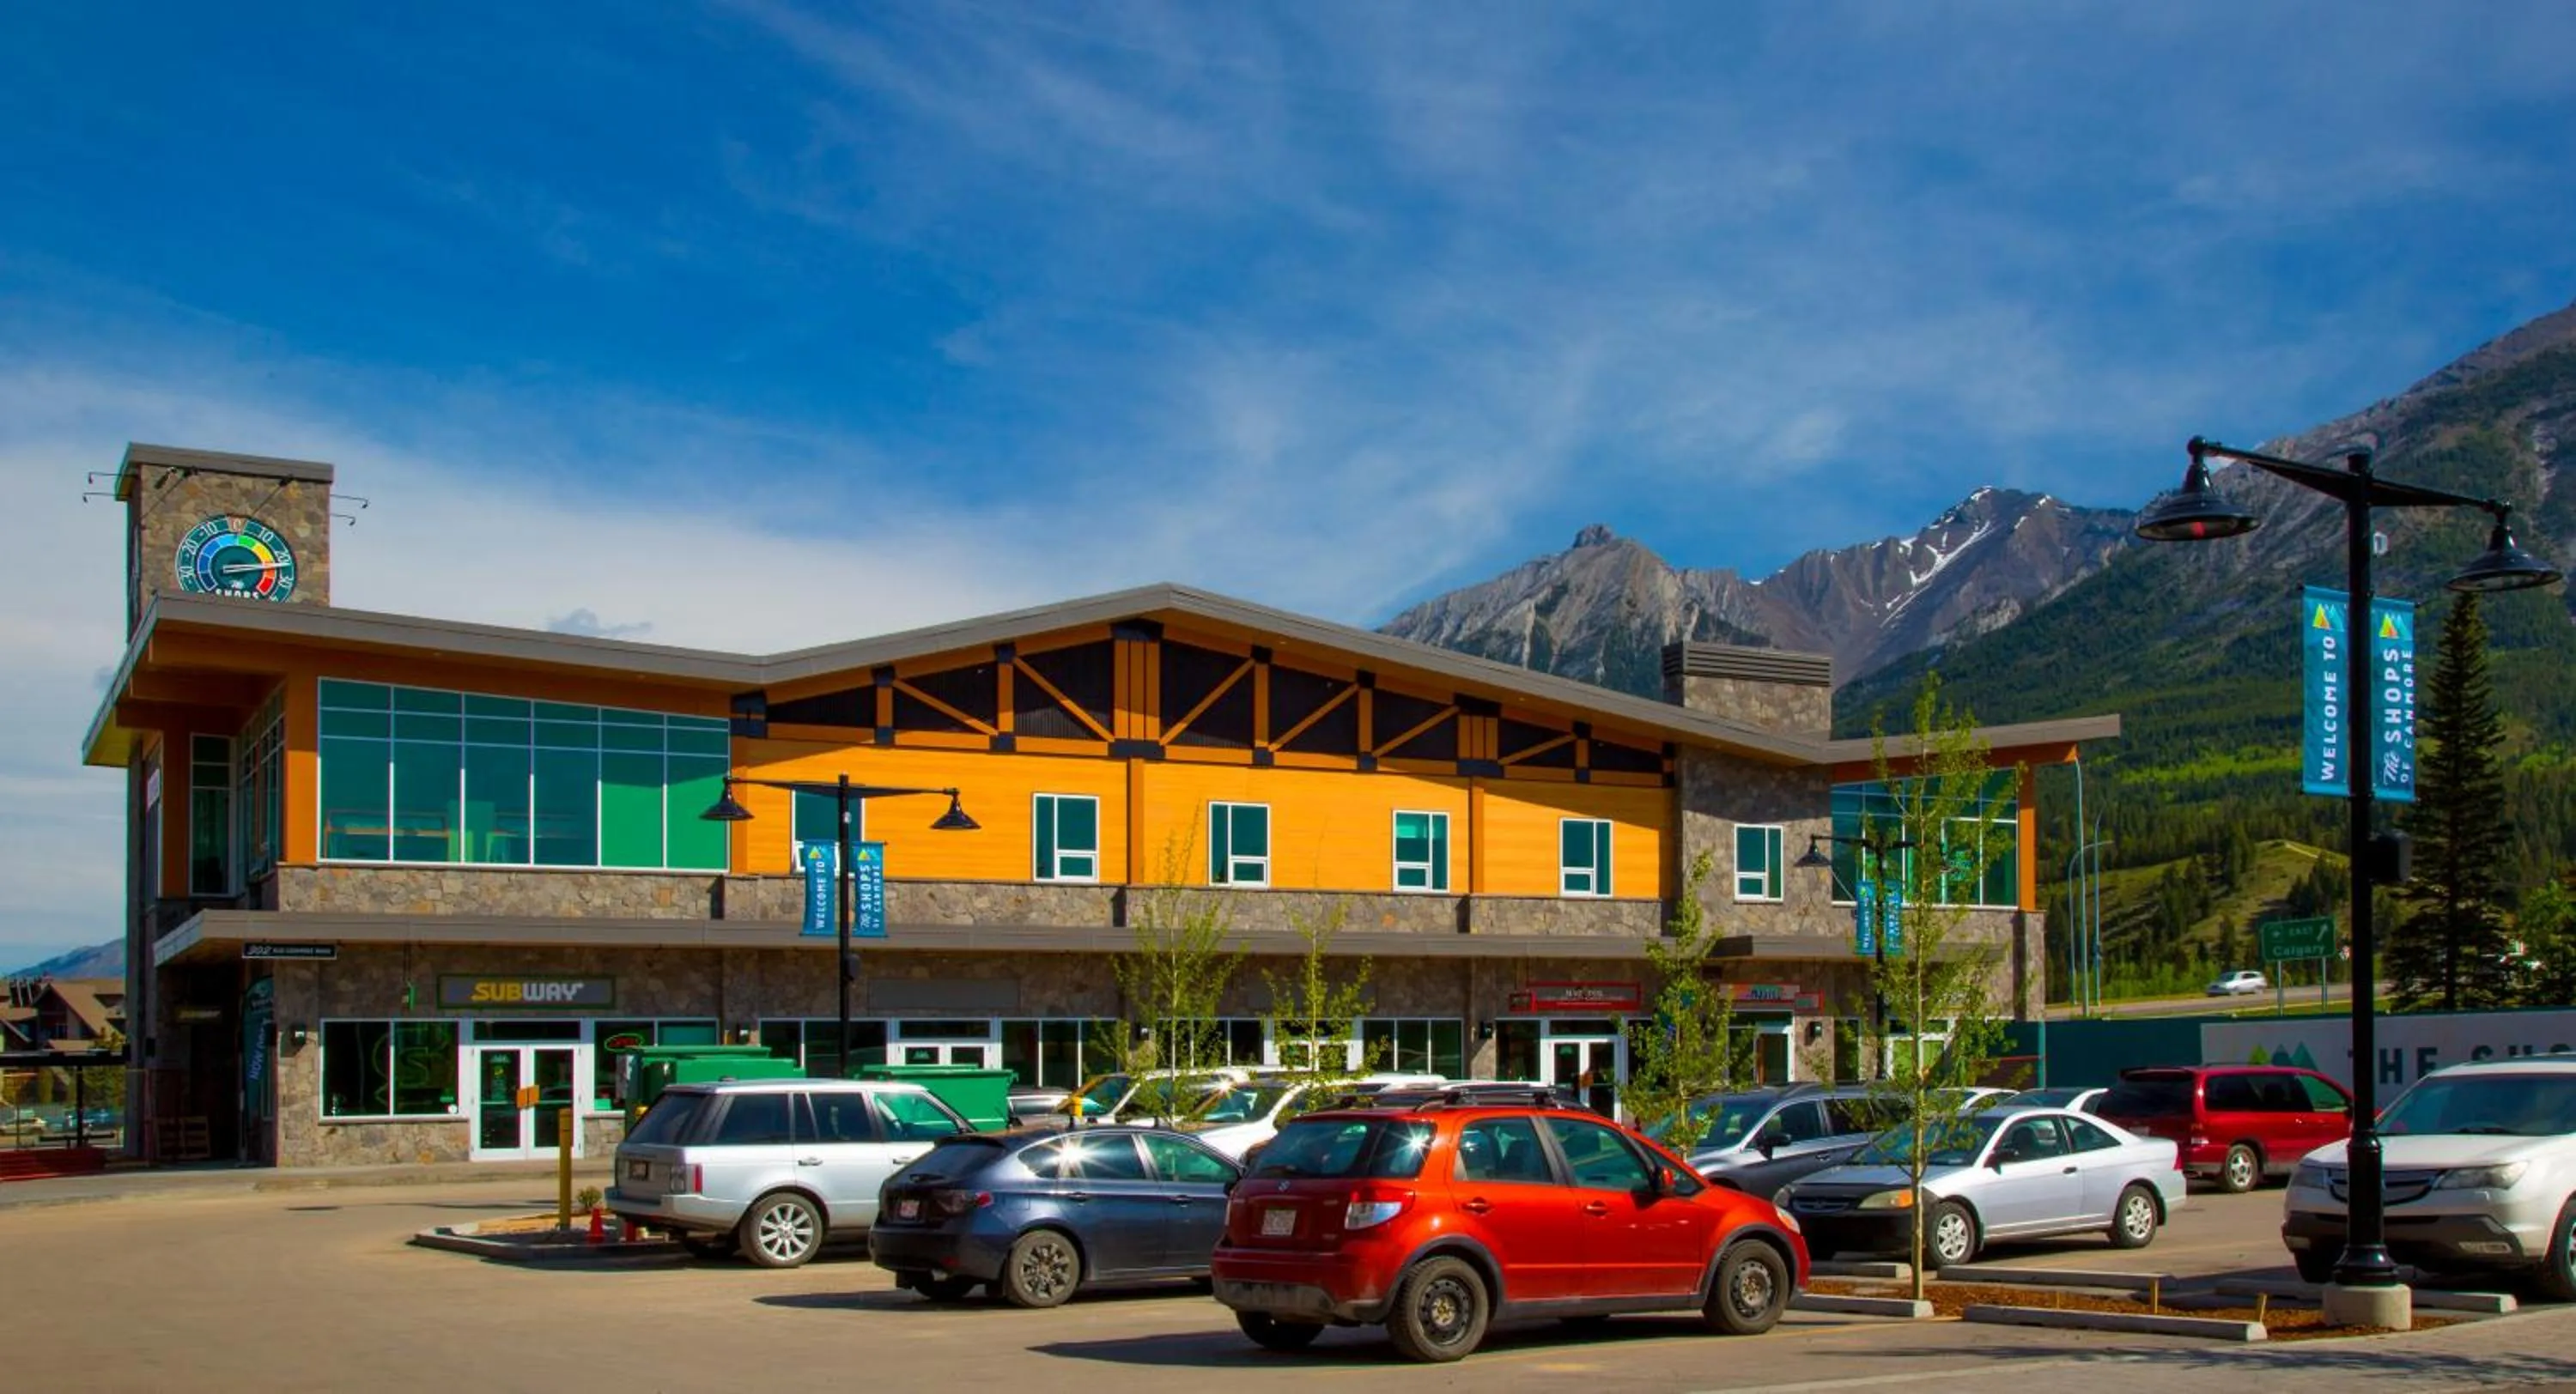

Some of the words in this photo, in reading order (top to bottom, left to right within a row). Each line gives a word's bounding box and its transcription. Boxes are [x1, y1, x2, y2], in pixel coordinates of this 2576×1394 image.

[258, 526, 275, 542] 10
[2322, 635, 2336, 661] TO
[2384, 648, 2402, 743] SHOPS
[2402, 649, 2415, 749] CANMORE
[2321, 670, 2338, 780] WELCOME
[2383, 749, 2401, 786] The
[816, 861, 825, 873] TO
[816, 877, 827, 929] WELCOME
[860, 864, 872, 911] SHOPS
[2272, 944, 2325, 958] Calgary
[471, 981, 584, 1002] SUBWAY
[2348, 1046, 2438, 1085] HE
